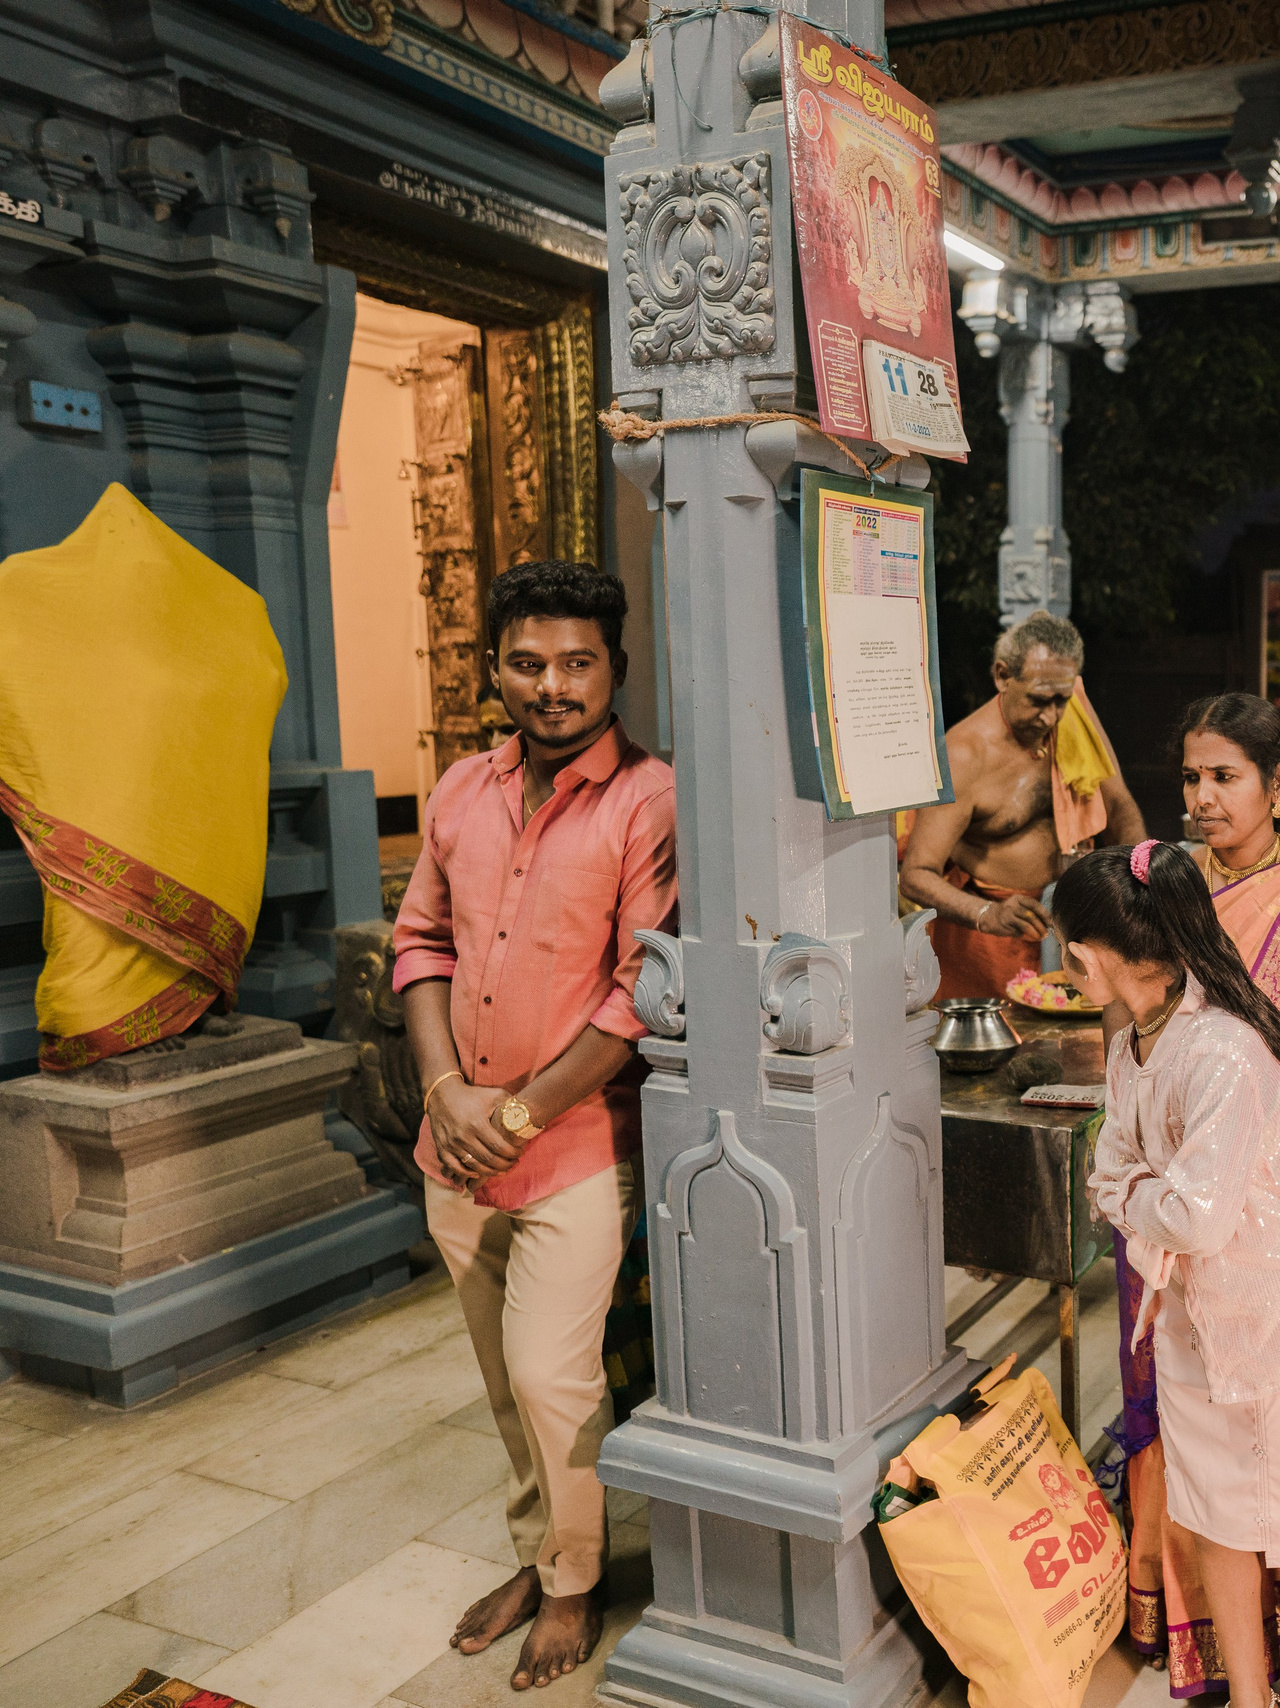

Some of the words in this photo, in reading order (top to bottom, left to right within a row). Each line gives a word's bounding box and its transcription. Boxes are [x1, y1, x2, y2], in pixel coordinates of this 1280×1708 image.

[799, 39, 834, 84] ஸ்ரீ
[835, 62, 935, 144] விஜயராம்
[926, 159, 940, 188] 63
[882, 358, 909, 396] 11
[917, 370, 939, 396] 28
[856, 514, 878, 530] 2022
